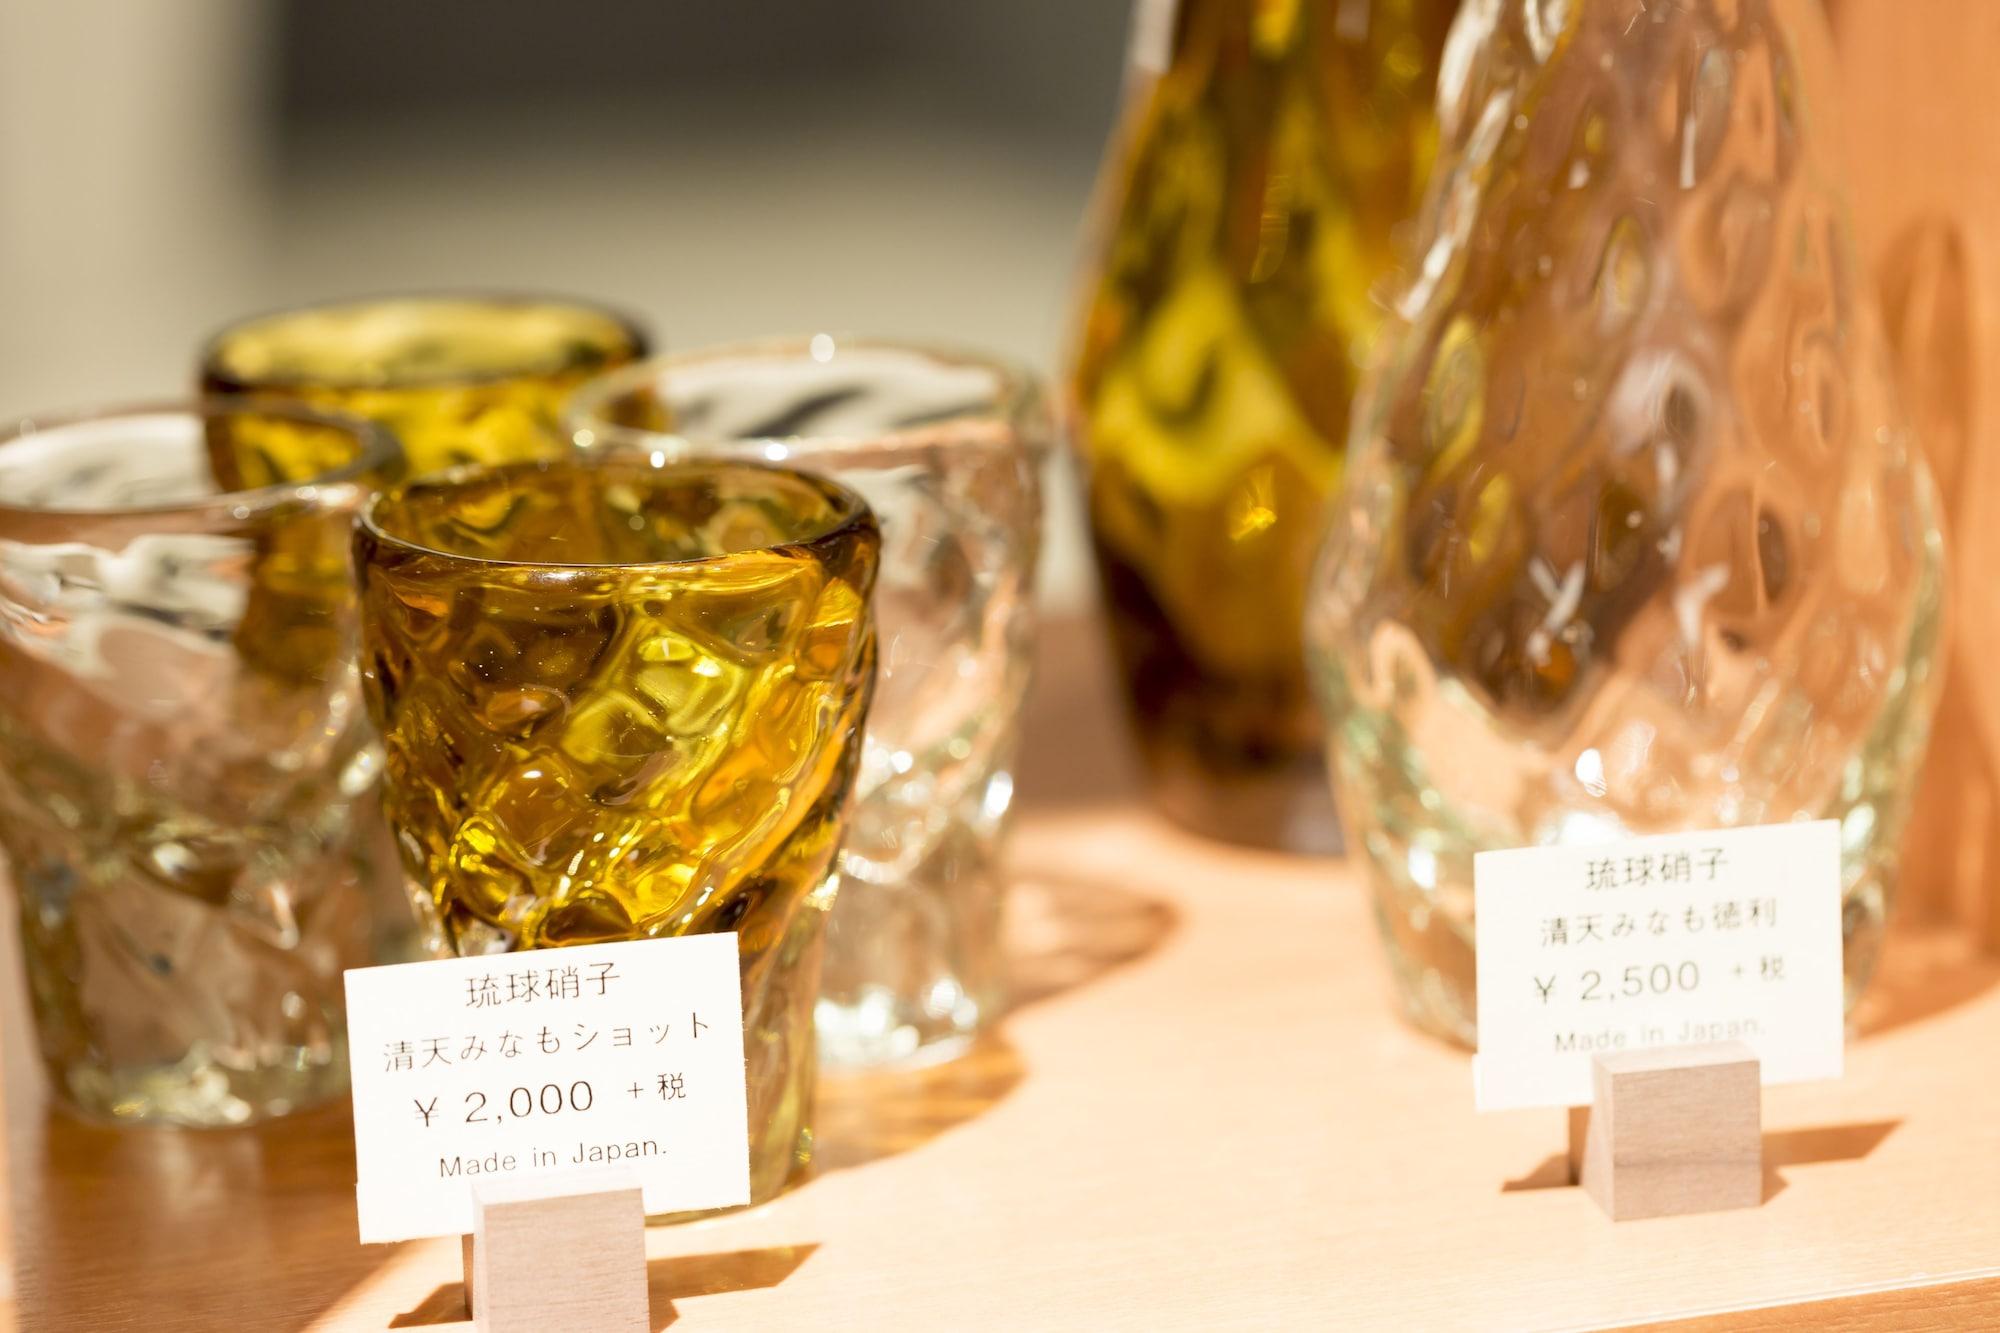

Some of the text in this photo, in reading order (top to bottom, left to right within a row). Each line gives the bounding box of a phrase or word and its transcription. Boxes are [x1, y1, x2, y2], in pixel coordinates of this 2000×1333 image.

[1585, 848, 1728, 891] 琉球硝子
[465, 962, 621, 1009] 琉球硝子
[1580, 960, 1701, 1002] 2,500
[384, 1012, 710, 1073] 清天みなもショット
[1554, 1017, 1767, 1052] Made in Japan.
[464, 1080, 594, 1125] 2,000
[439, 1139, 668, 1178] Made in Japan.
